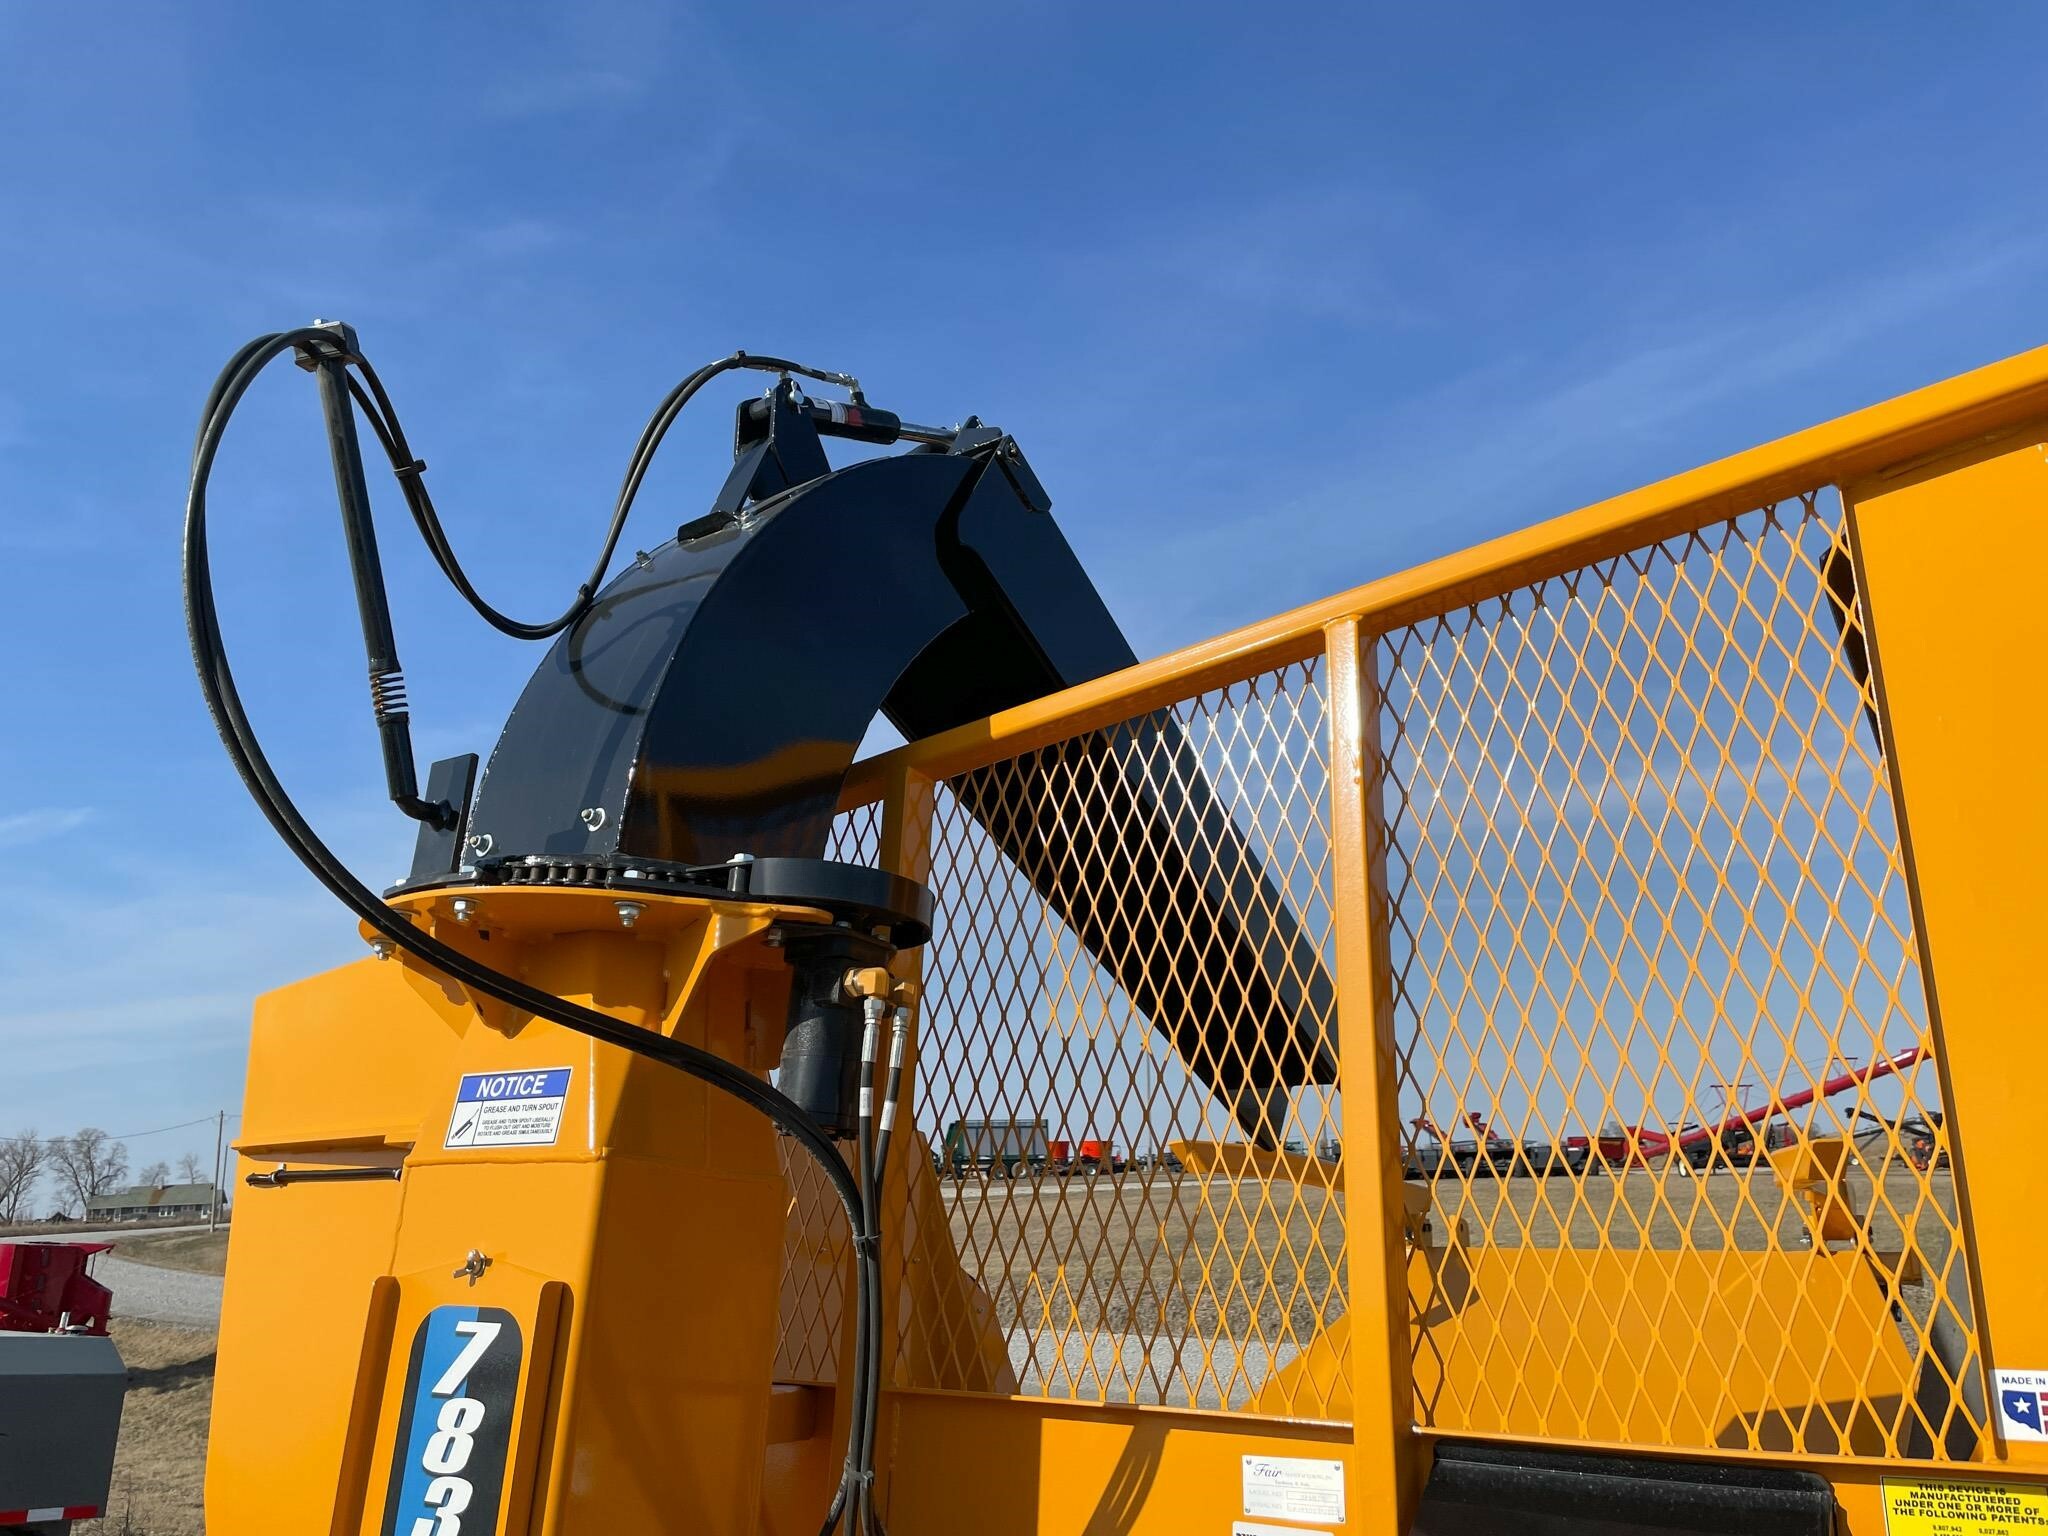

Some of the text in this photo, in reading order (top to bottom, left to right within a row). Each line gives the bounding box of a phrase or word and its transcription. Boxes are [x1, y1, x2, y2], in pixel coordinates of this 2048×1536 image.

[476, 1074, 548, 1098] NOTICE
[483, 1105, 508, 1114] GREASE
[522, 1104, 538, 1112] TURN
[538, 1102, 559, 1111] SPOUT
[2001, 1376, 2046, 1385] MADE IN
[1253, 1463, 1282, 1478] Fair
[1917, 1483, 2007, 1496] THIS DEVICE IS
[1910, 1491, 2021, 1506] MANUFACTURERED
[1893, 1507, 1915, 1516] THE
[1919, 1509, 1987, 1521] FOLLOWING
[1895, 1499, 2040, 1516] UNDER ONE OR MORE OF
